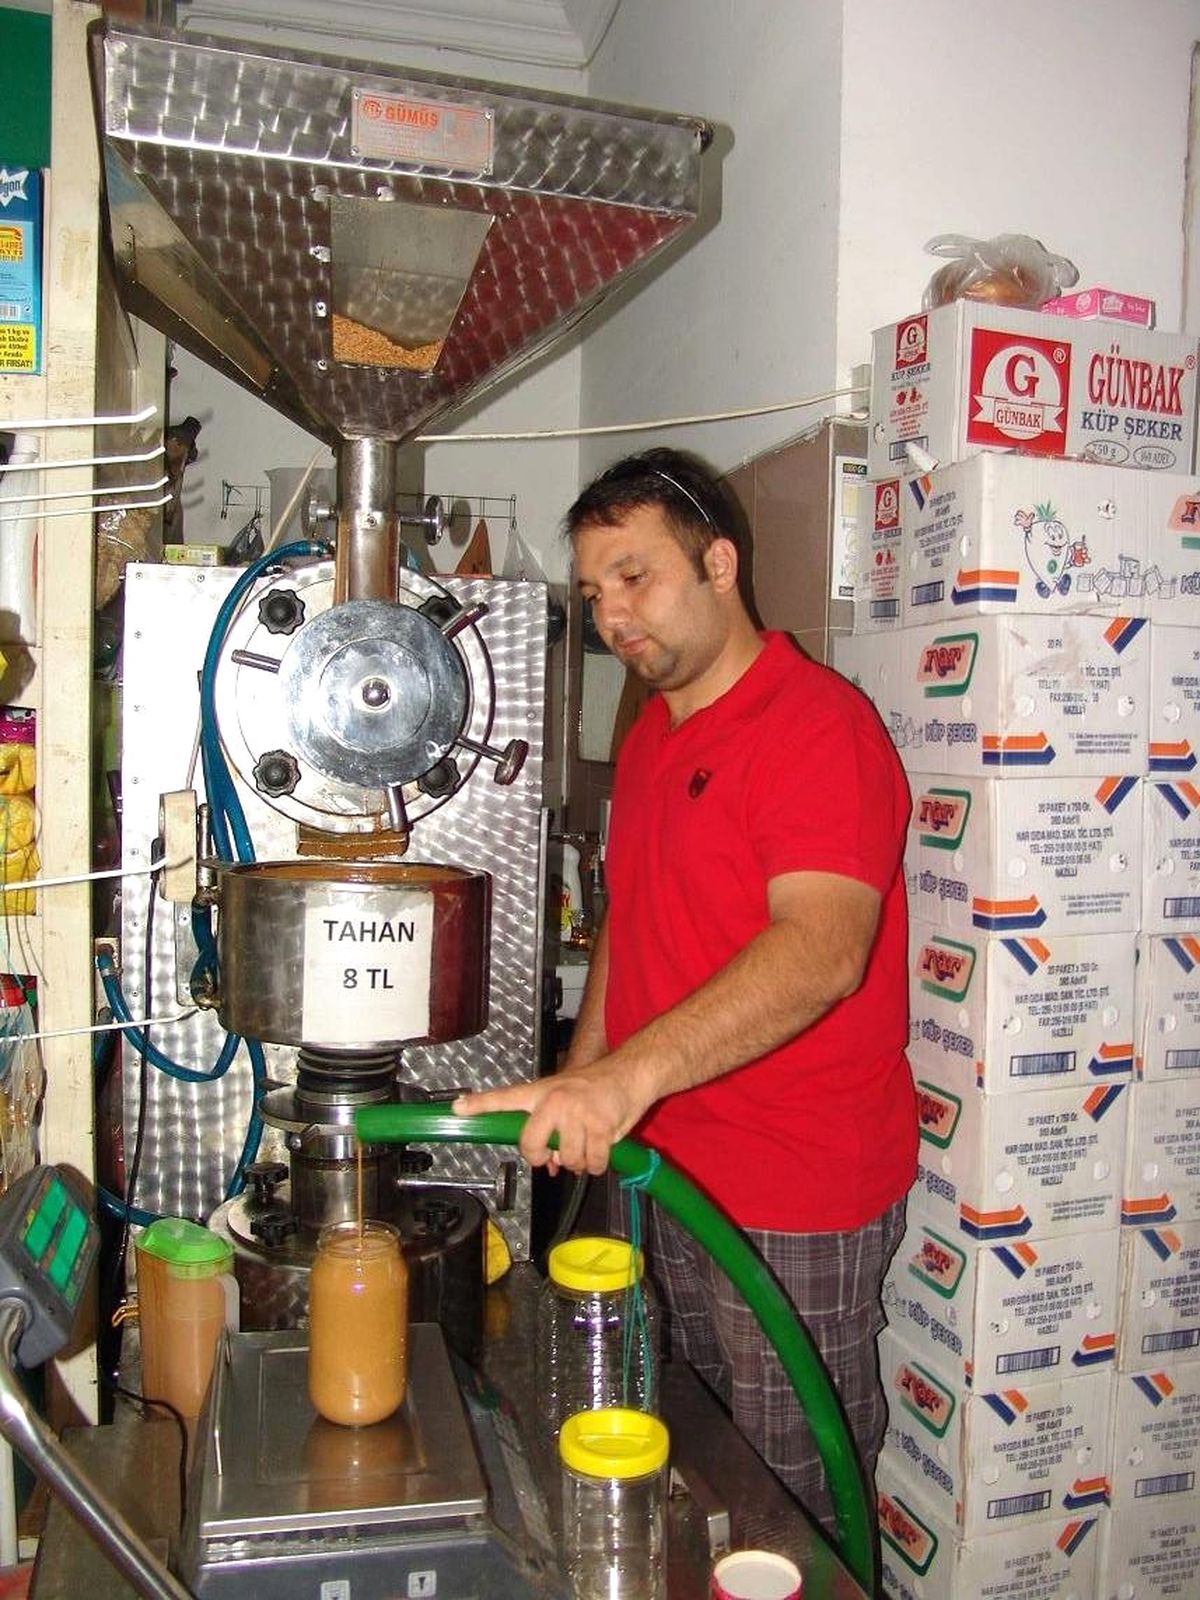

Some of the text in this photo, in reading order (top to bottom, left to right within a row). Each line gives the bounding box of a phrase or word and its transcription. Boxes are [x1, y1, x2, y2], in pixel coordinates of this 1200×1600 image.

[1005, 353, 1039, 398] G
[1088, 343, 1184, 416] GÜNBAK
[996, 407, 1041, 428] GÜNBAK
[1080, 409, 1183, 441] KÜP ŞEKER
[323, 919, 415, 942] TAHAN
[343, 968, 394, 989] 8 TL
